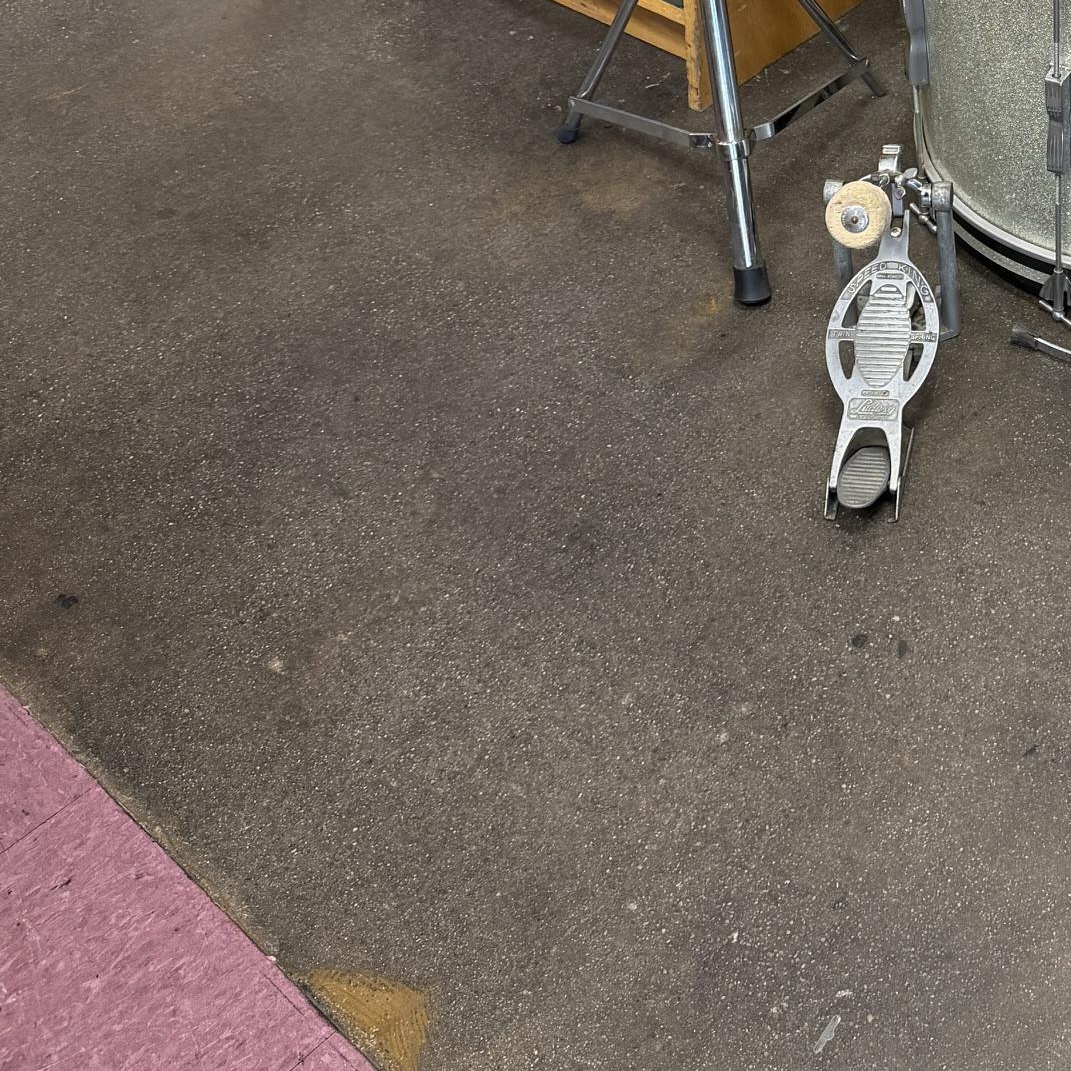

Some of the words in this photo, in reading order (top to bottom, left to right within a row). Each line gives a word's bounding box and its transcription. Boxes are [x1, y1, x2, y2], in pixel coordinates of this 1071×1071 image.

[848, 262, 887, 294] SPEED
[899, 264, 930, 297] KING
[832, 330, 851, 338] TWIN
